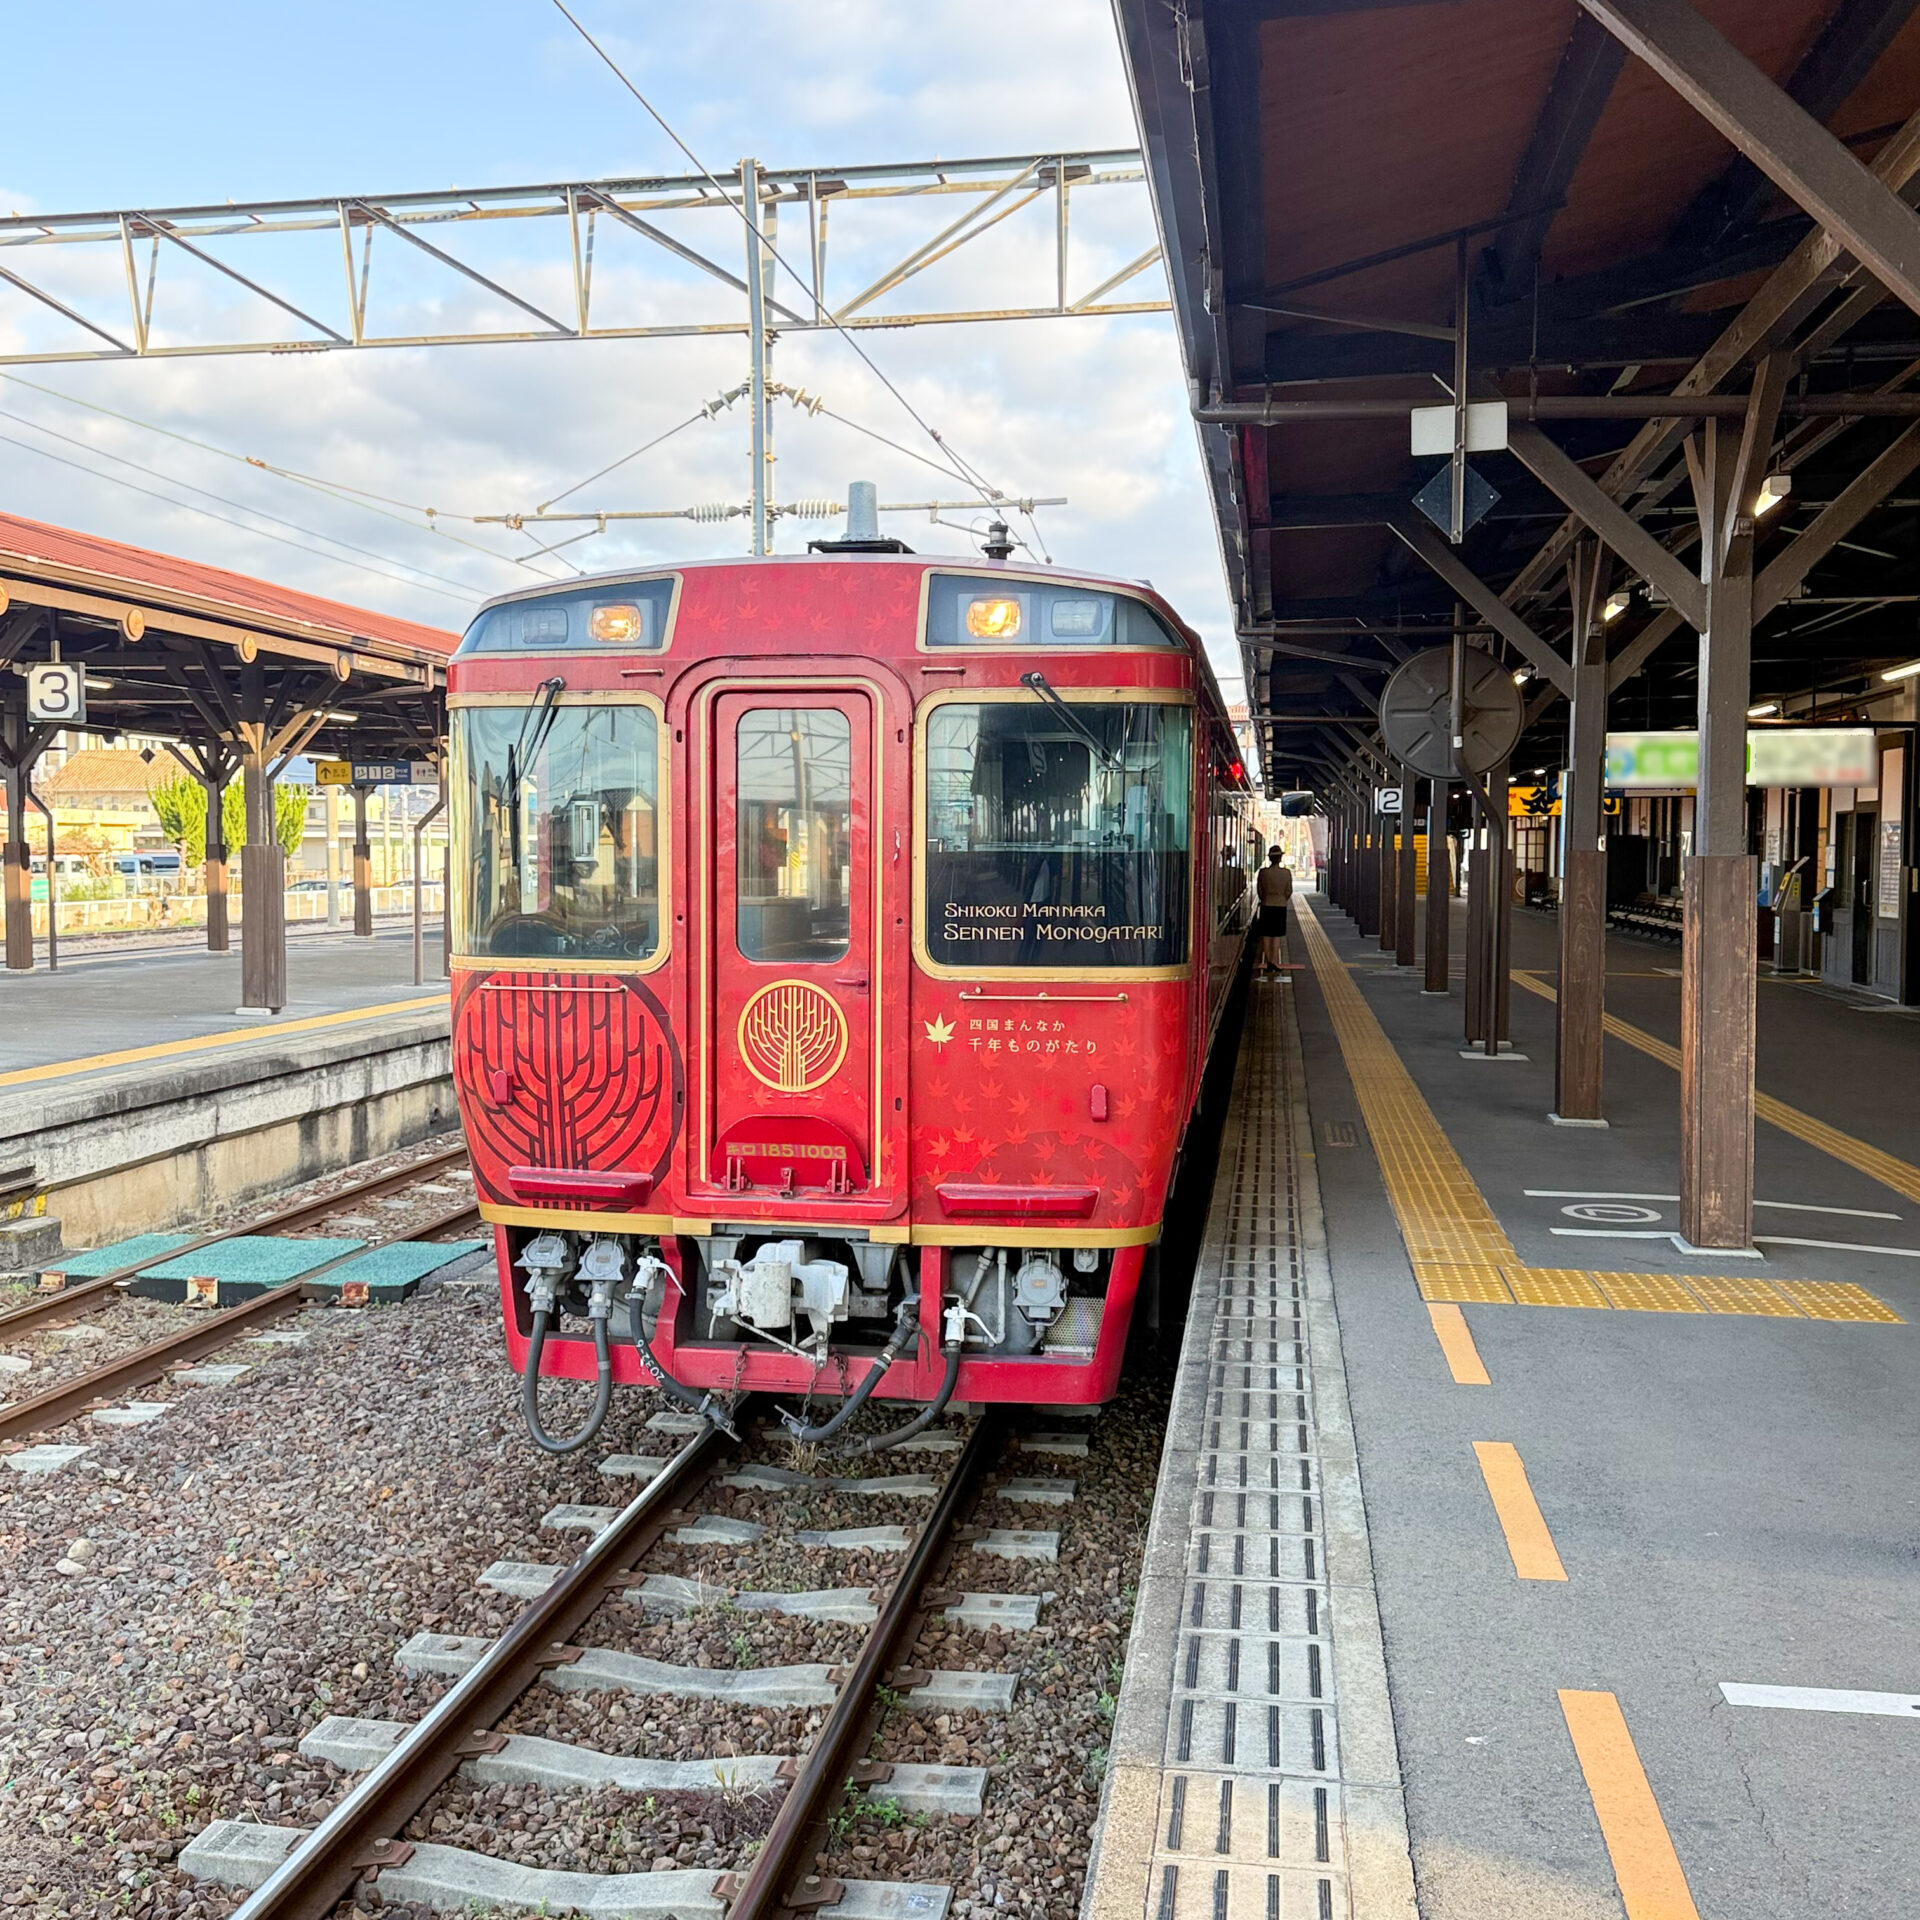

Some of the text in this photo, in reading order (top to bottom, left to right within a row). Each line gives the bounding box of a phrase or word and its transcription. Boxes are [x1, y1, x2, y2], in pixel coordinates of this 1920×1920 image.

[39, 672, 69, 712] 3
[384, 768, 393, 778] 2
[1383, 790, 1400, 811] 2
[969, 1018, 1066, 1032] 四国まんなか
[967, 1037, 1098, 1055] 千年ものがたり
